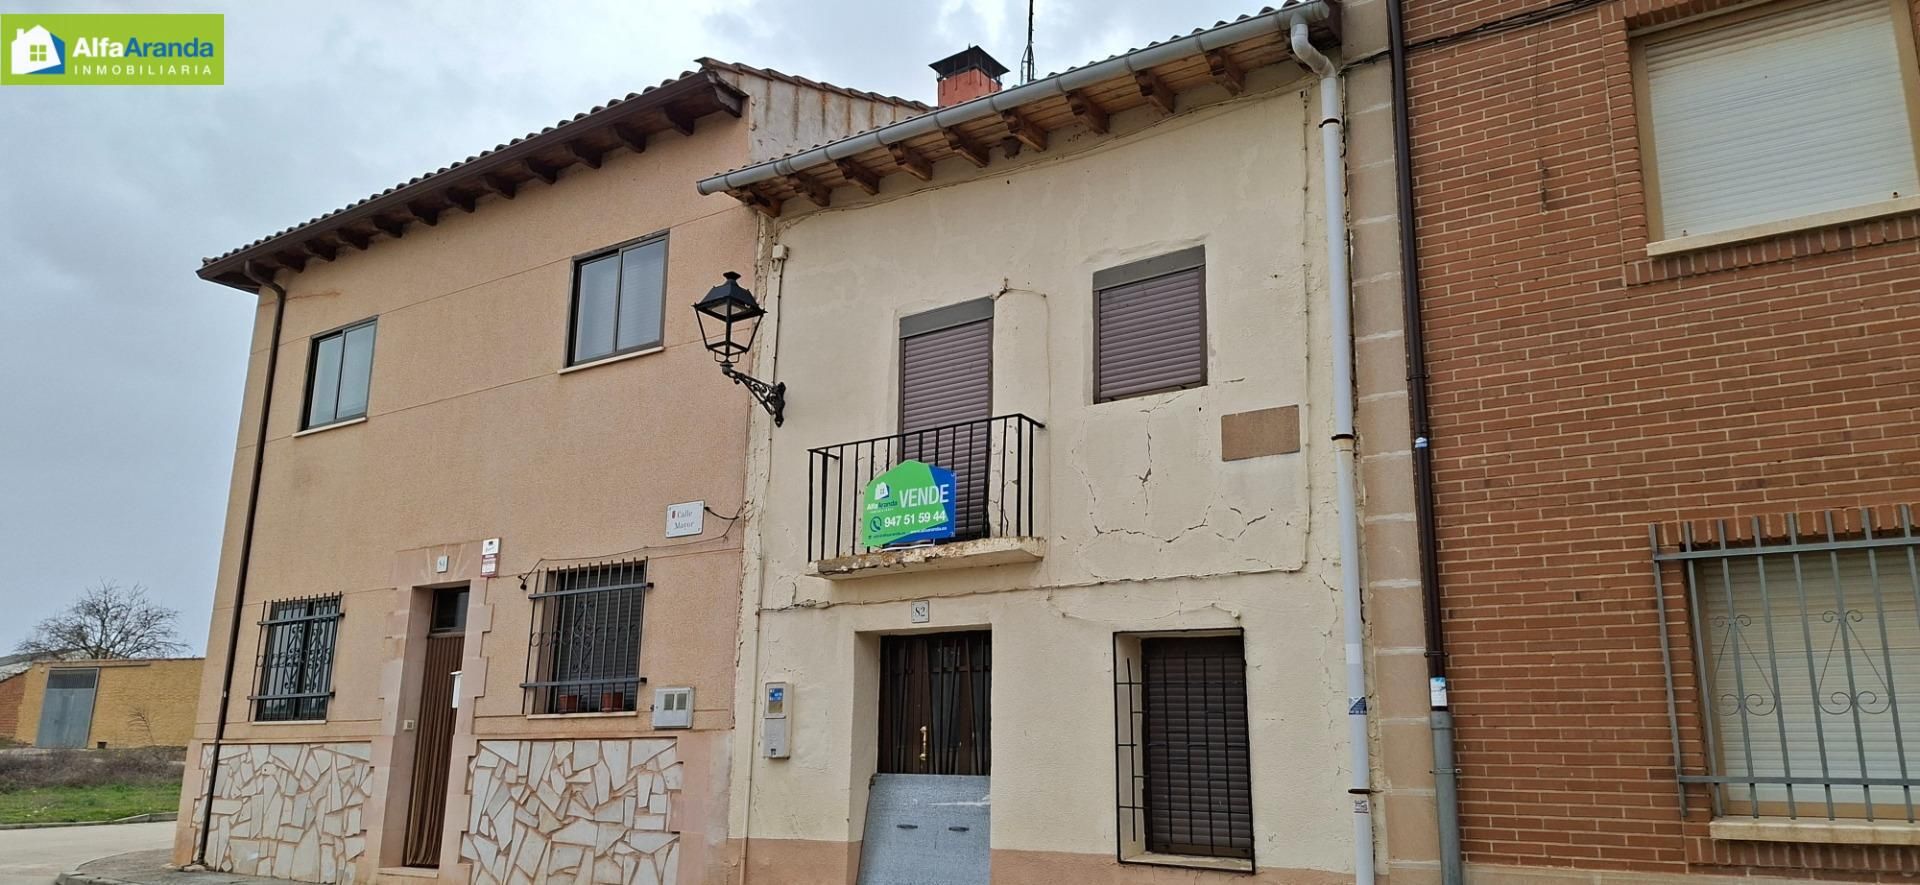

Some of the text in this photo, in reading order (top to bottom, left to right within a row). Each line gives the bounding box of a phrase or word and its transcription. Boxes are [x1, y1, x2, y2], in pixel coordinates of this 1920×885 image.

[899, 484, 949, 508] VENDE
[677, 510, 693, 518] Calle
[884, 510, 945, 527] 947 51 59 44
[674, 521, 694, 530] Mayor
[915, 607, 926, 616] 82
